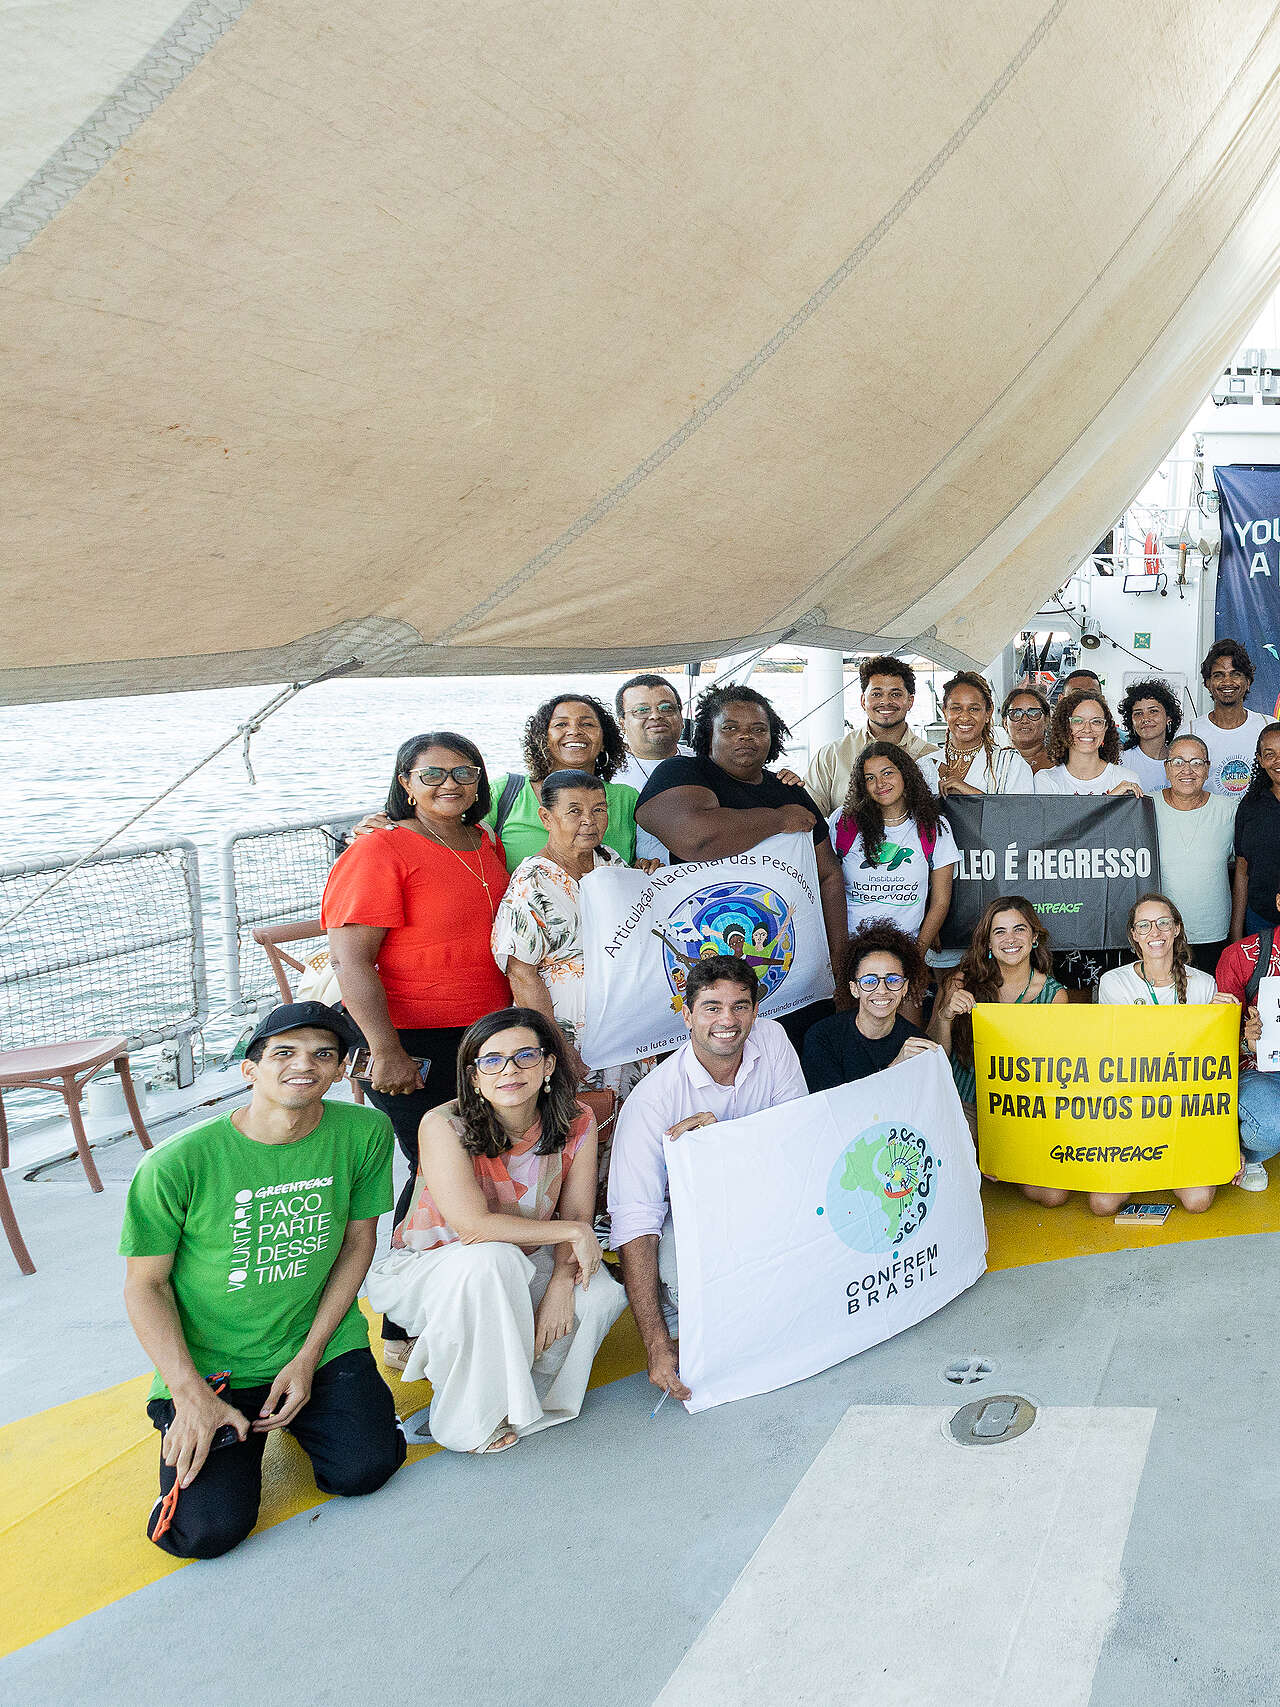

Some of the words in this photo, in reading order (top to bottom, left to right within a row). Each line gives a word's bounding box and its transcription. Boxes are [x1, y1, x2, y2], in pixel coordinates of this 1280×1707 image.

[1250, 552, 1271, 578] A
[1004, 842, 1018, 880] É
[1027, 847, 1151, 880] REGRESSO
[852, 892, 918, 901] Preservada
[853, 881, 918, 891] Itamaracá
[604, 887, 655, 959] Articulação
[650, 856, 724, 891] Nacional
[729, 853, 757, 865] das
[762, 856, 816, 905] Pescadoras
[636, 1045, 648, 1054] Na
[650, 1040, 667, 1052] luta
[676, 1034, 687, 1042] na
[987, 1055, 1089, 1090] JUSTIÇA
[1098, 1052, 1232, 1083] CLIMÁTICA
[988, 1092, 1046, 1119] PARA
[1055, 1095, 1132, 1120] POVOS
[1141, 1094, 1172, 1119] DO
[1180, 1092, 1231, 1117] MAR
[1050, 1144, 1168, 1163] GREENPEACE
[254, 1176, 334, 1198] GREENPEACE
[259, 1193, 322, 1222] FAÇO
[227, 1189, 253, 1293] VOLUNTÁRIO
[258, 1212, 332, 1243] PARTE
[256, 1232, 330, 1264] DESSE
[254, 1258, 308, 1285] TIME
[846, 1243, 938, 1298] CONFREM
[847, 1263, 938, 1315] BRASIL
